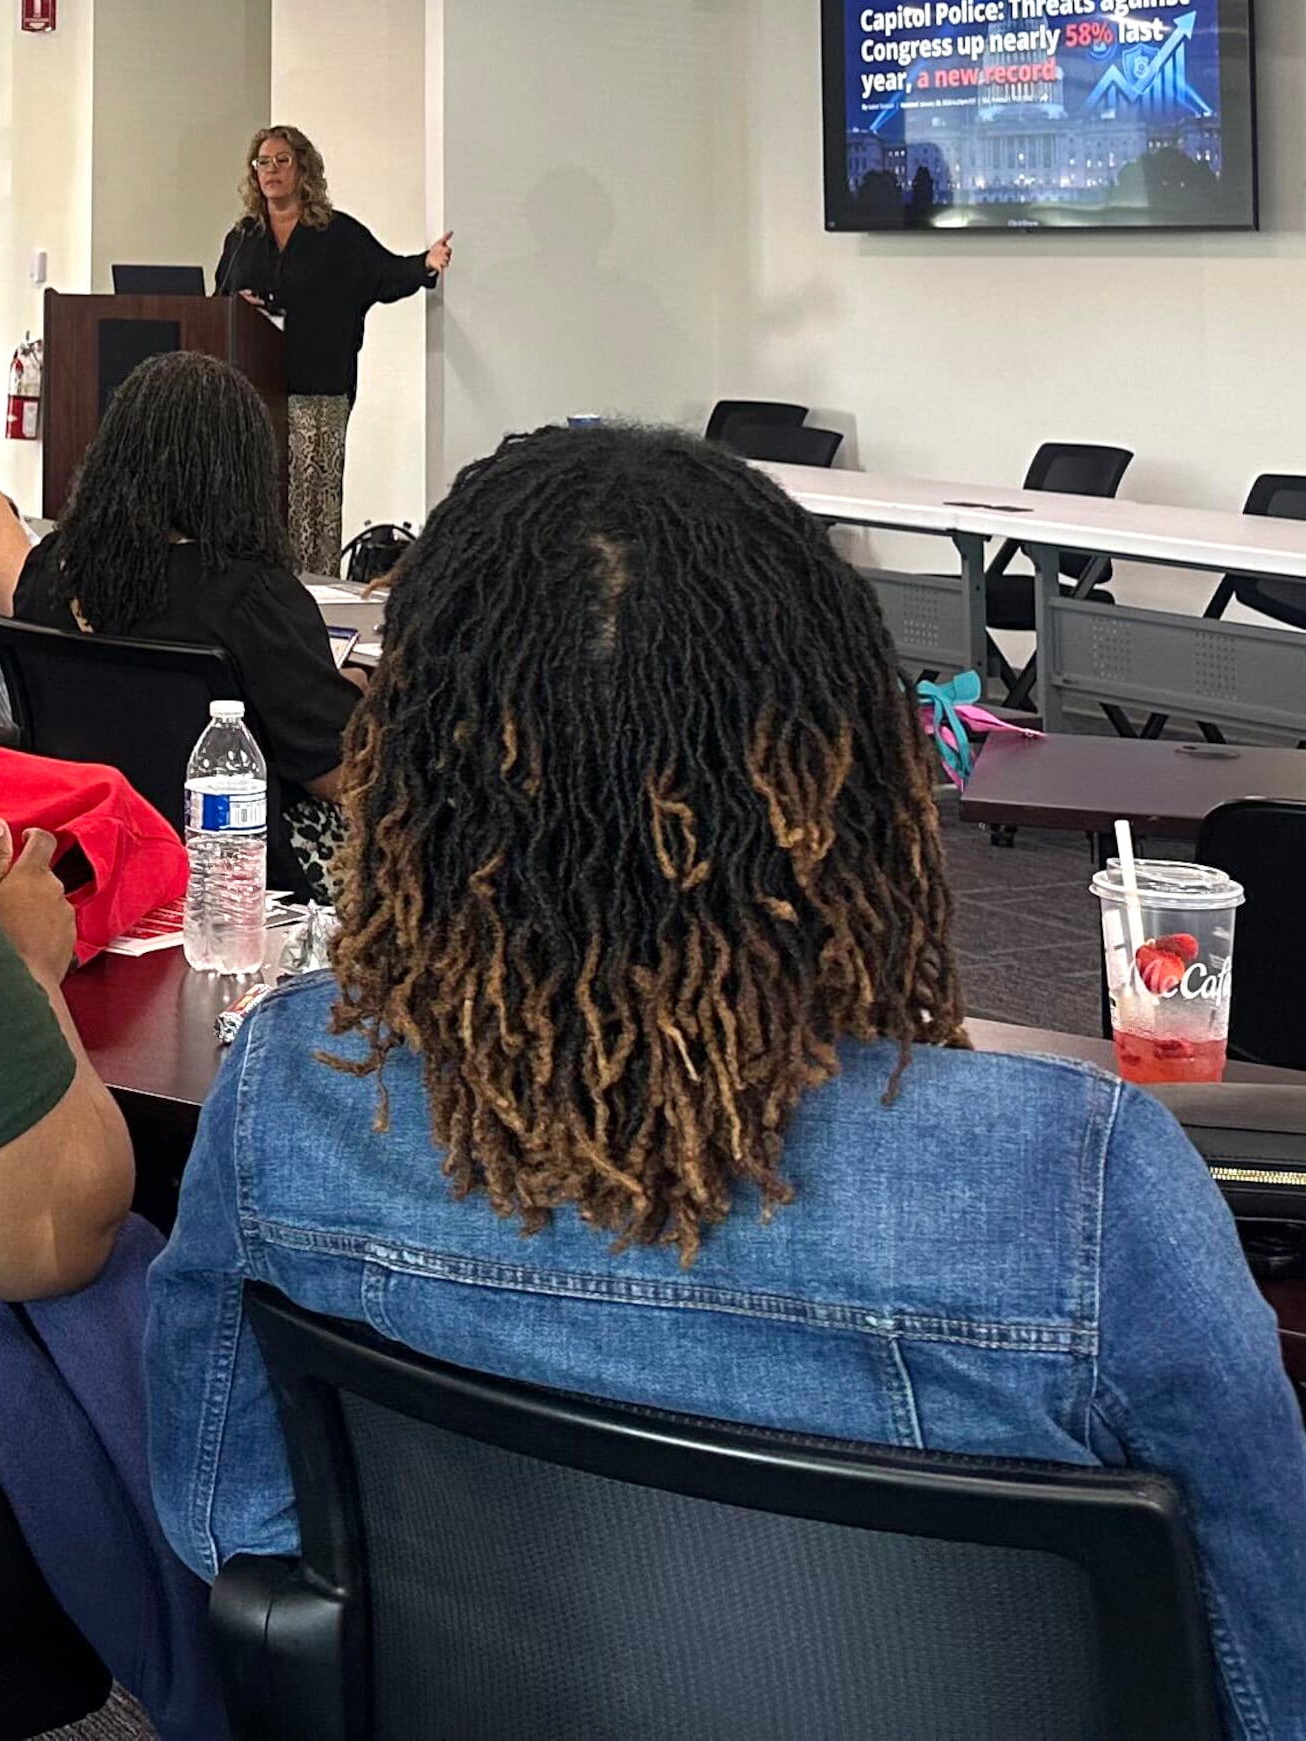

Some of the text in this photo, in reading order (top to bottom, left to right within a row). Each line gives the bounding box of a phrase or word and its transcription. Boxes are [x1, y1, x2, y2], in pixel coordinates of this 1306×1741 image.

[860, 3, 931, 36] Capitol
[936, 0, 1004, 26] Police:
[1008, 0, 1095, 20] Threats
[861, 17, 1164, 66] Congress up nearly 58% last
[861, 56, 1057, 98] year, a new record
